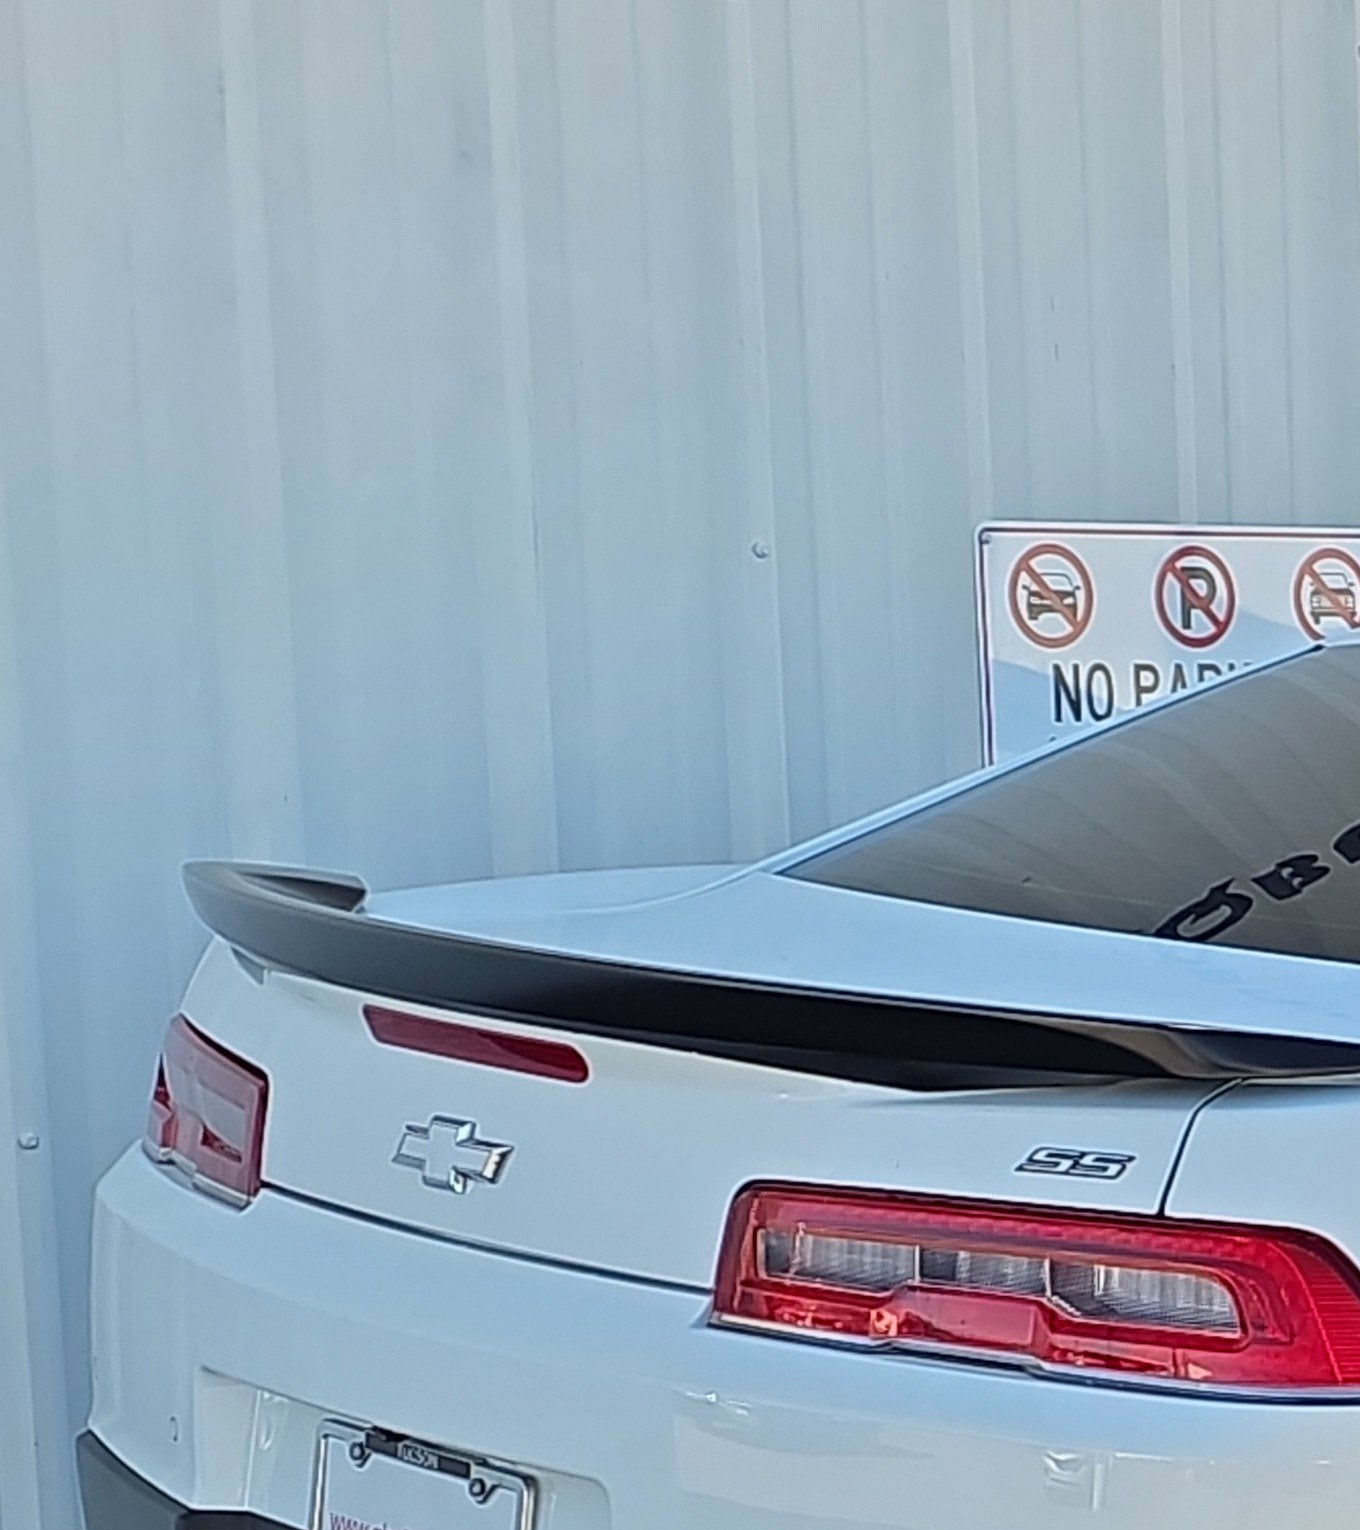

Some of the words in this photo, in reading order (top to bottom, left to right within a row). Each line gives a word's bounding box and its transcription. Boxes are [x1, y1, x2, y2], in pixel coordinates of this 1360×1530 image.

[1051, 662, 1115, 723] NO
[1134, 662, 1252, 707] PA
[1014, 1147, 1137, 1180] SS
